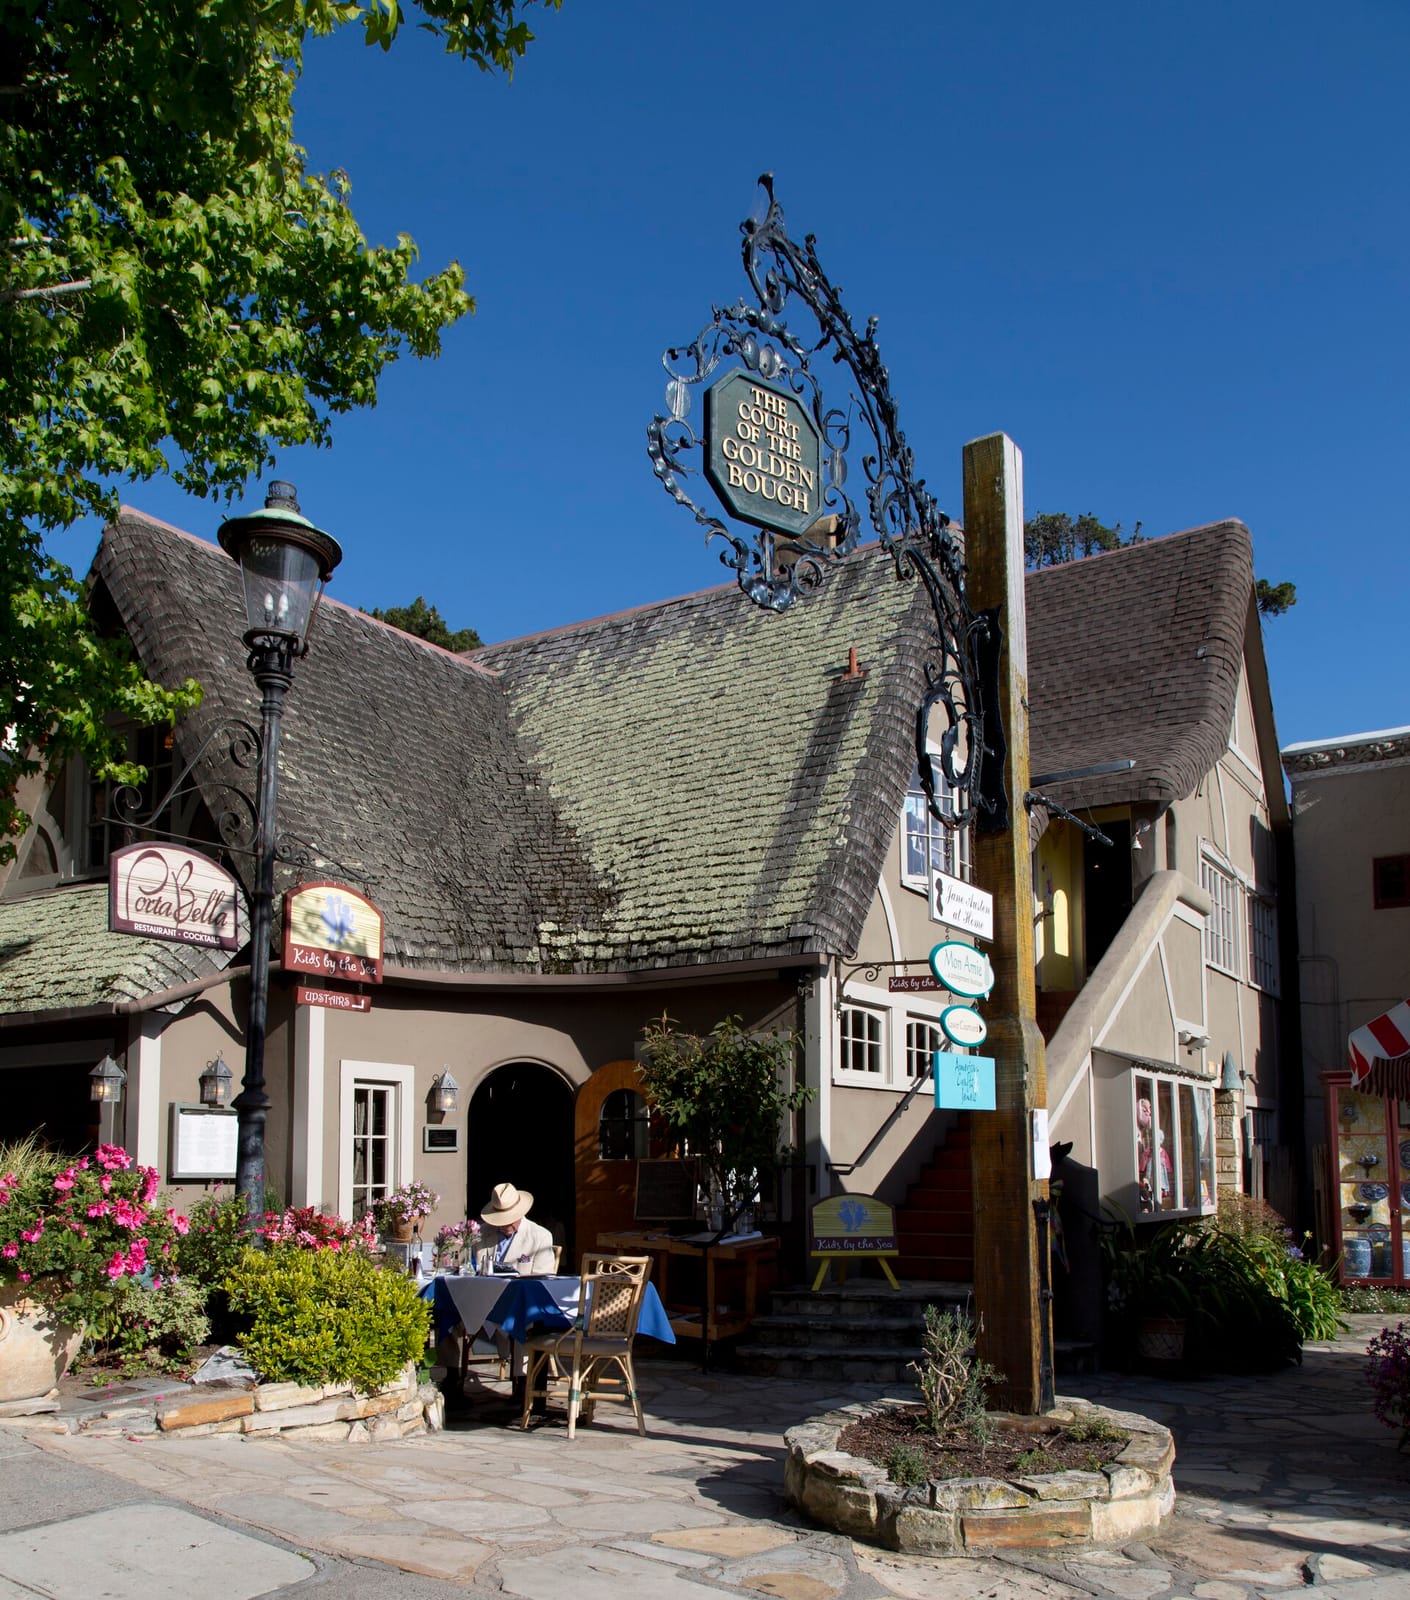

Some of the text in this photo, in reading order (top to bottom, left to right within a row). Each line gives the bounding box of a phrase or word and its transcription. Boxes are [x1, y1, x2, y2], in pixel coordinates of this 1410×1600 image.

[751, 387, 788, 417] THE
[738, 402, 800, 441] COURT
[737, 421, 802, 462] OF THE
[722, 437, 815, 491] GOLDEN
[727, 463, 809, 514] BOUGH
[134, 922, 177, 937] RESTAURANT
[293, 947, 377, 976] Kids by the Sea
[943, 948, 962, 970] Mon
[890, 978, 909, 989] Kids
[910, 978, 920, 991] by
[921, 977, 935, 987] the
[304, 991, 350, 1007] UPSTAIRS
[816, 1238, 893, 1252] Kids by the Sea
